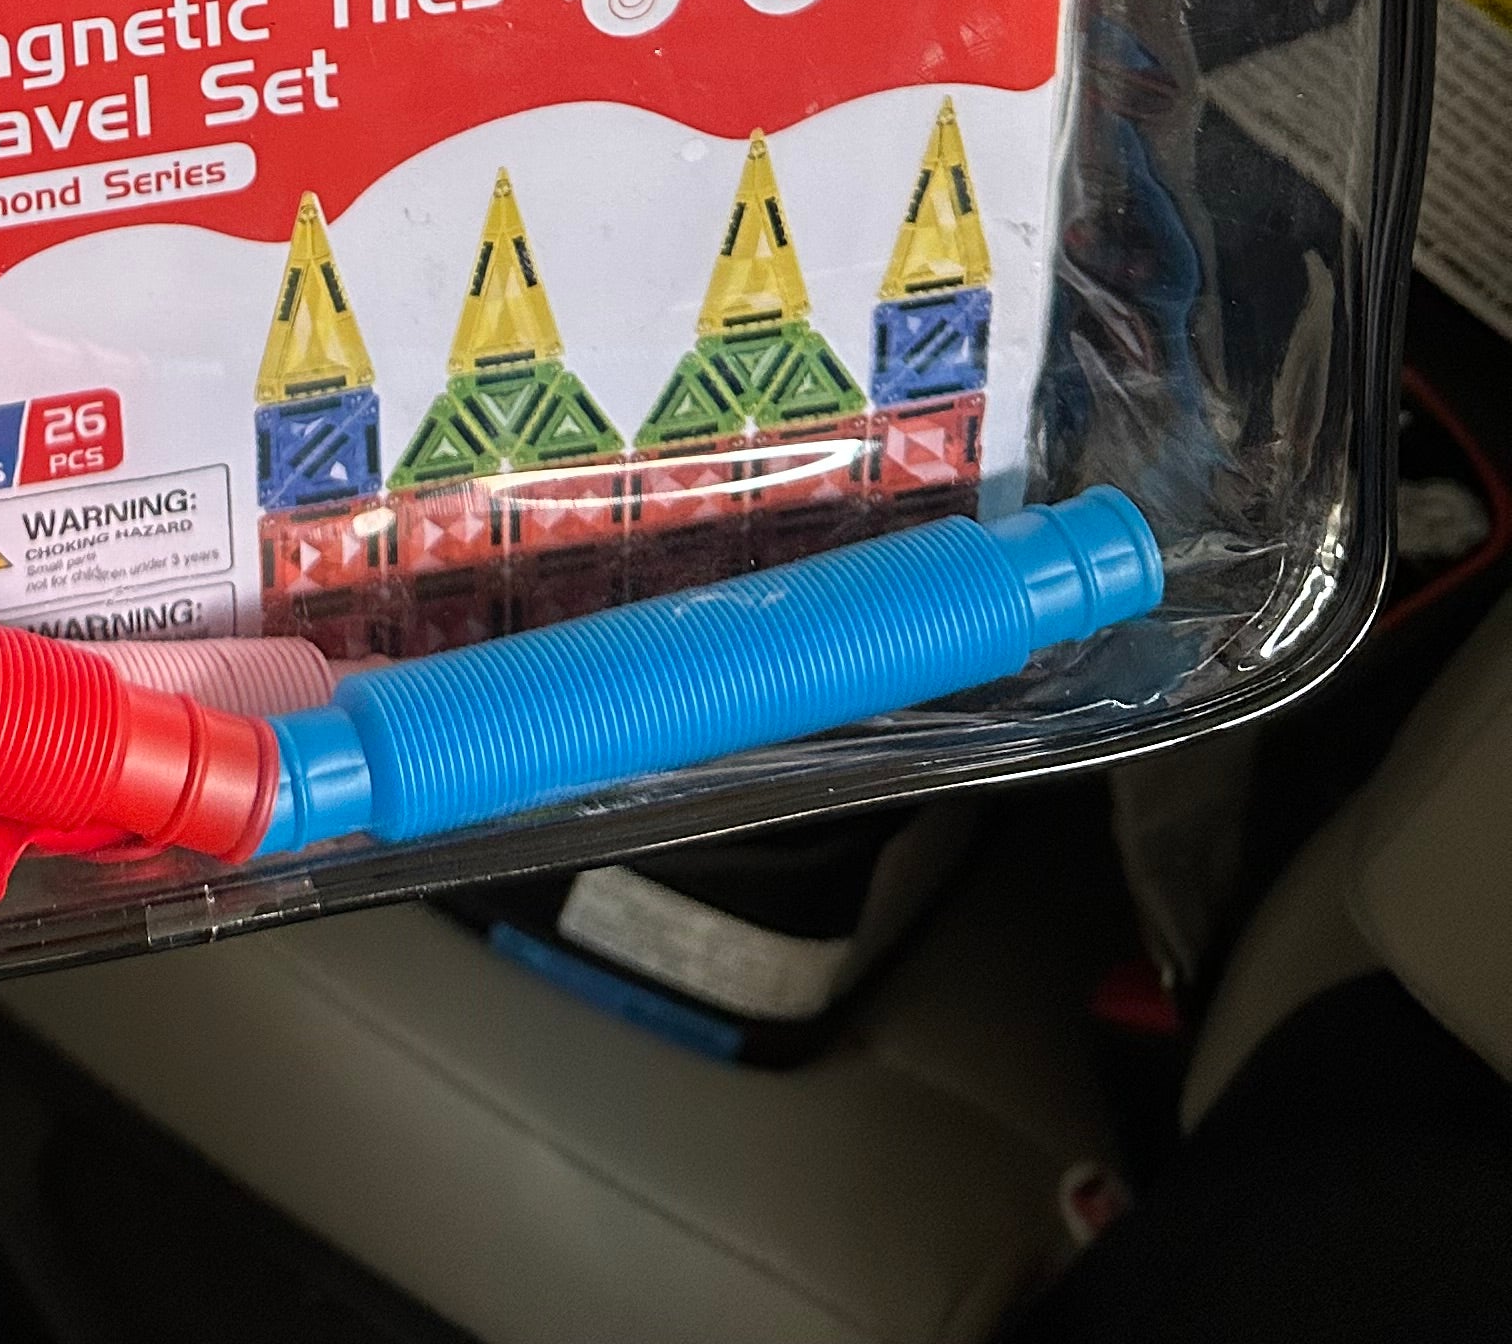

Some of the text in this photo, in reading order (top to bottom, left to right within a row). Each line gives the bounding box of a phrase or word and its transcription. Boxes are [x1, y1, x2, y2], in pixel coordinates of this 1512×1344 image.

[201, 48, 339, 129] Set
[103, 156, 227, 201] Series
[43, 400, 107, 446] 26
[48, 446, 105, 475] PCS
[22, 489, 198, 541] WARNING:
[24, 518, 194, 561] CHOKING HAZARD
[27, 598, 203, 641] WARNING:
